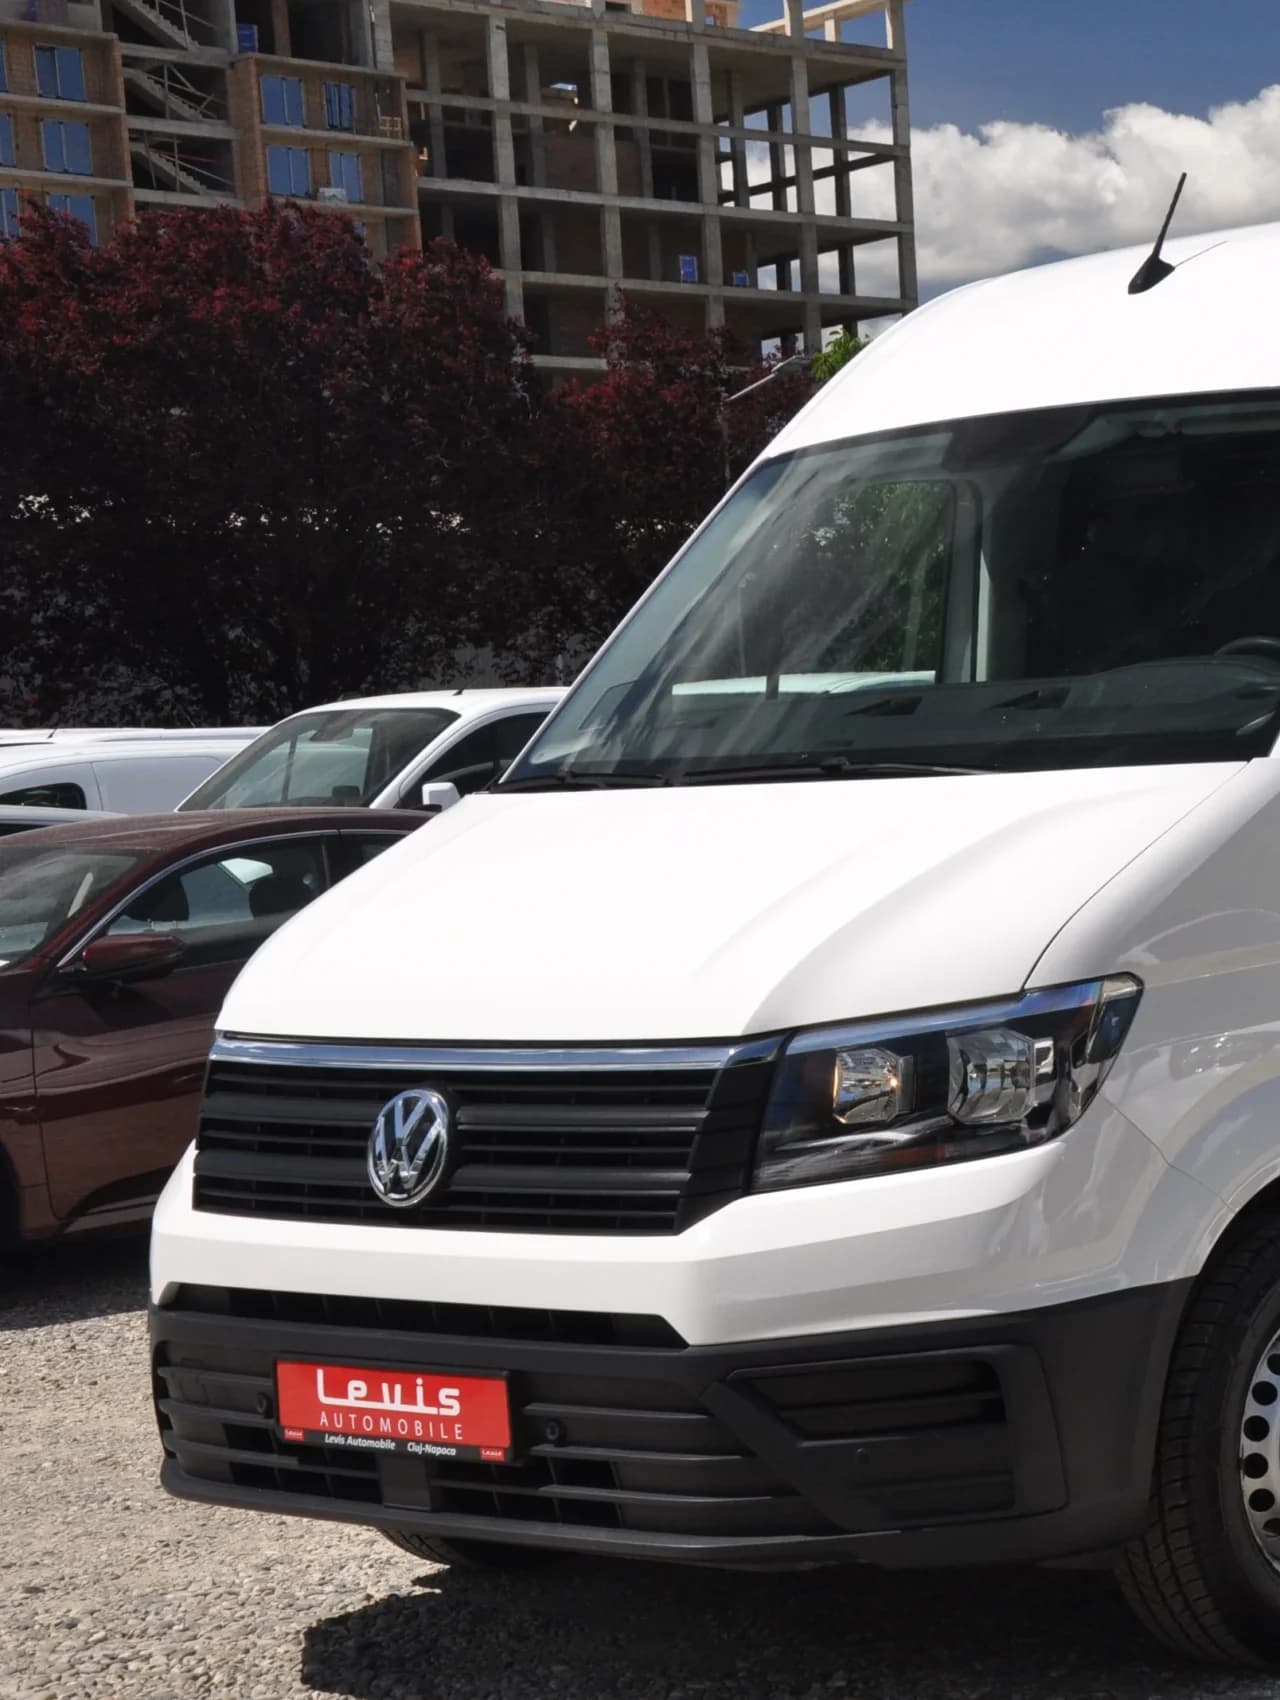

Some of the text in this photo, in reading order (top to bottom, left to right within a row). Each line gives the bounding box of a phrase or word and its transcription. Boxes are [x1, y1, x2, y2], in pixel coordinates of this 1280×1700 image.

[317, 1369, 460, 1416] Levis
[320, 1411, 463, 1440] AUTOMOBILE
[325, 1433, 457, 1457] Levis Automobile Cluj-Napoca
